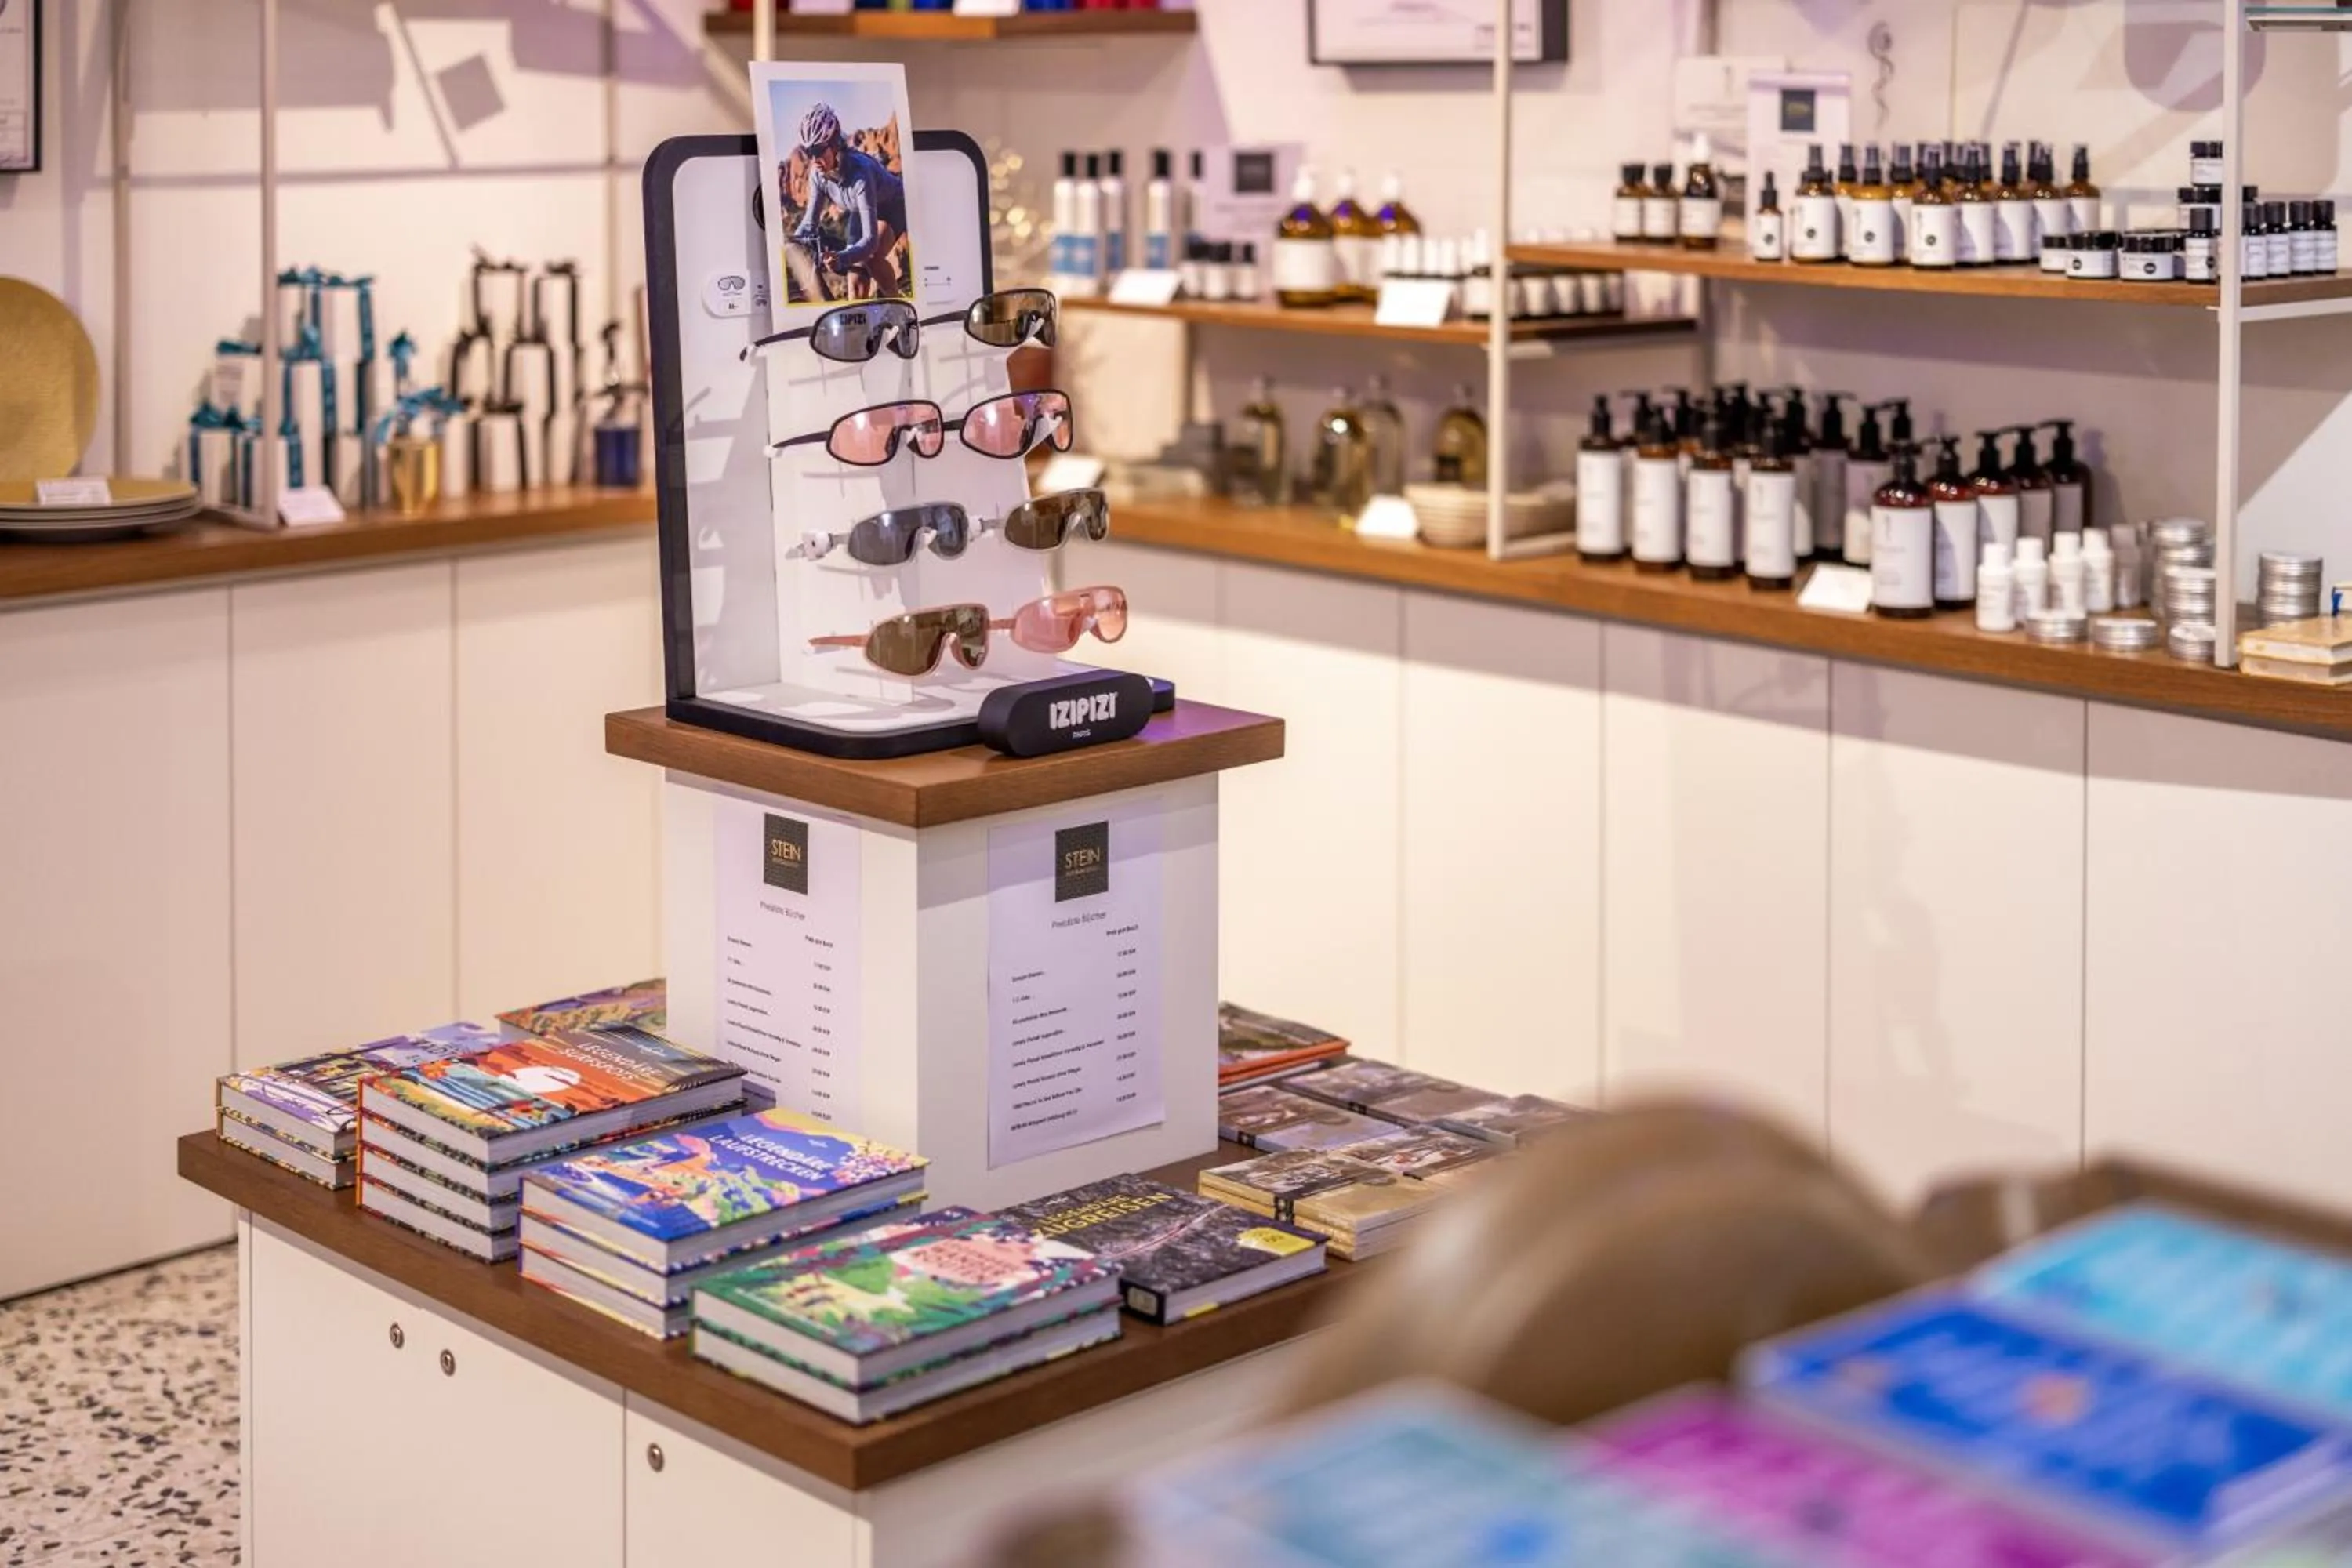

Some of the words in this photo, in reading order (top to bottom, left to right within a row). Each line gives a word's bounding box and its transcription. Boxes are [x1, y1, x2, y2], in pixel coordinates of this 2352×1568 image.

[1049, 691, 1118, 730] IZIPIZI
[771, 840, 801, 861] STEIN
[1065, 847, 1101, 869] STEIN
